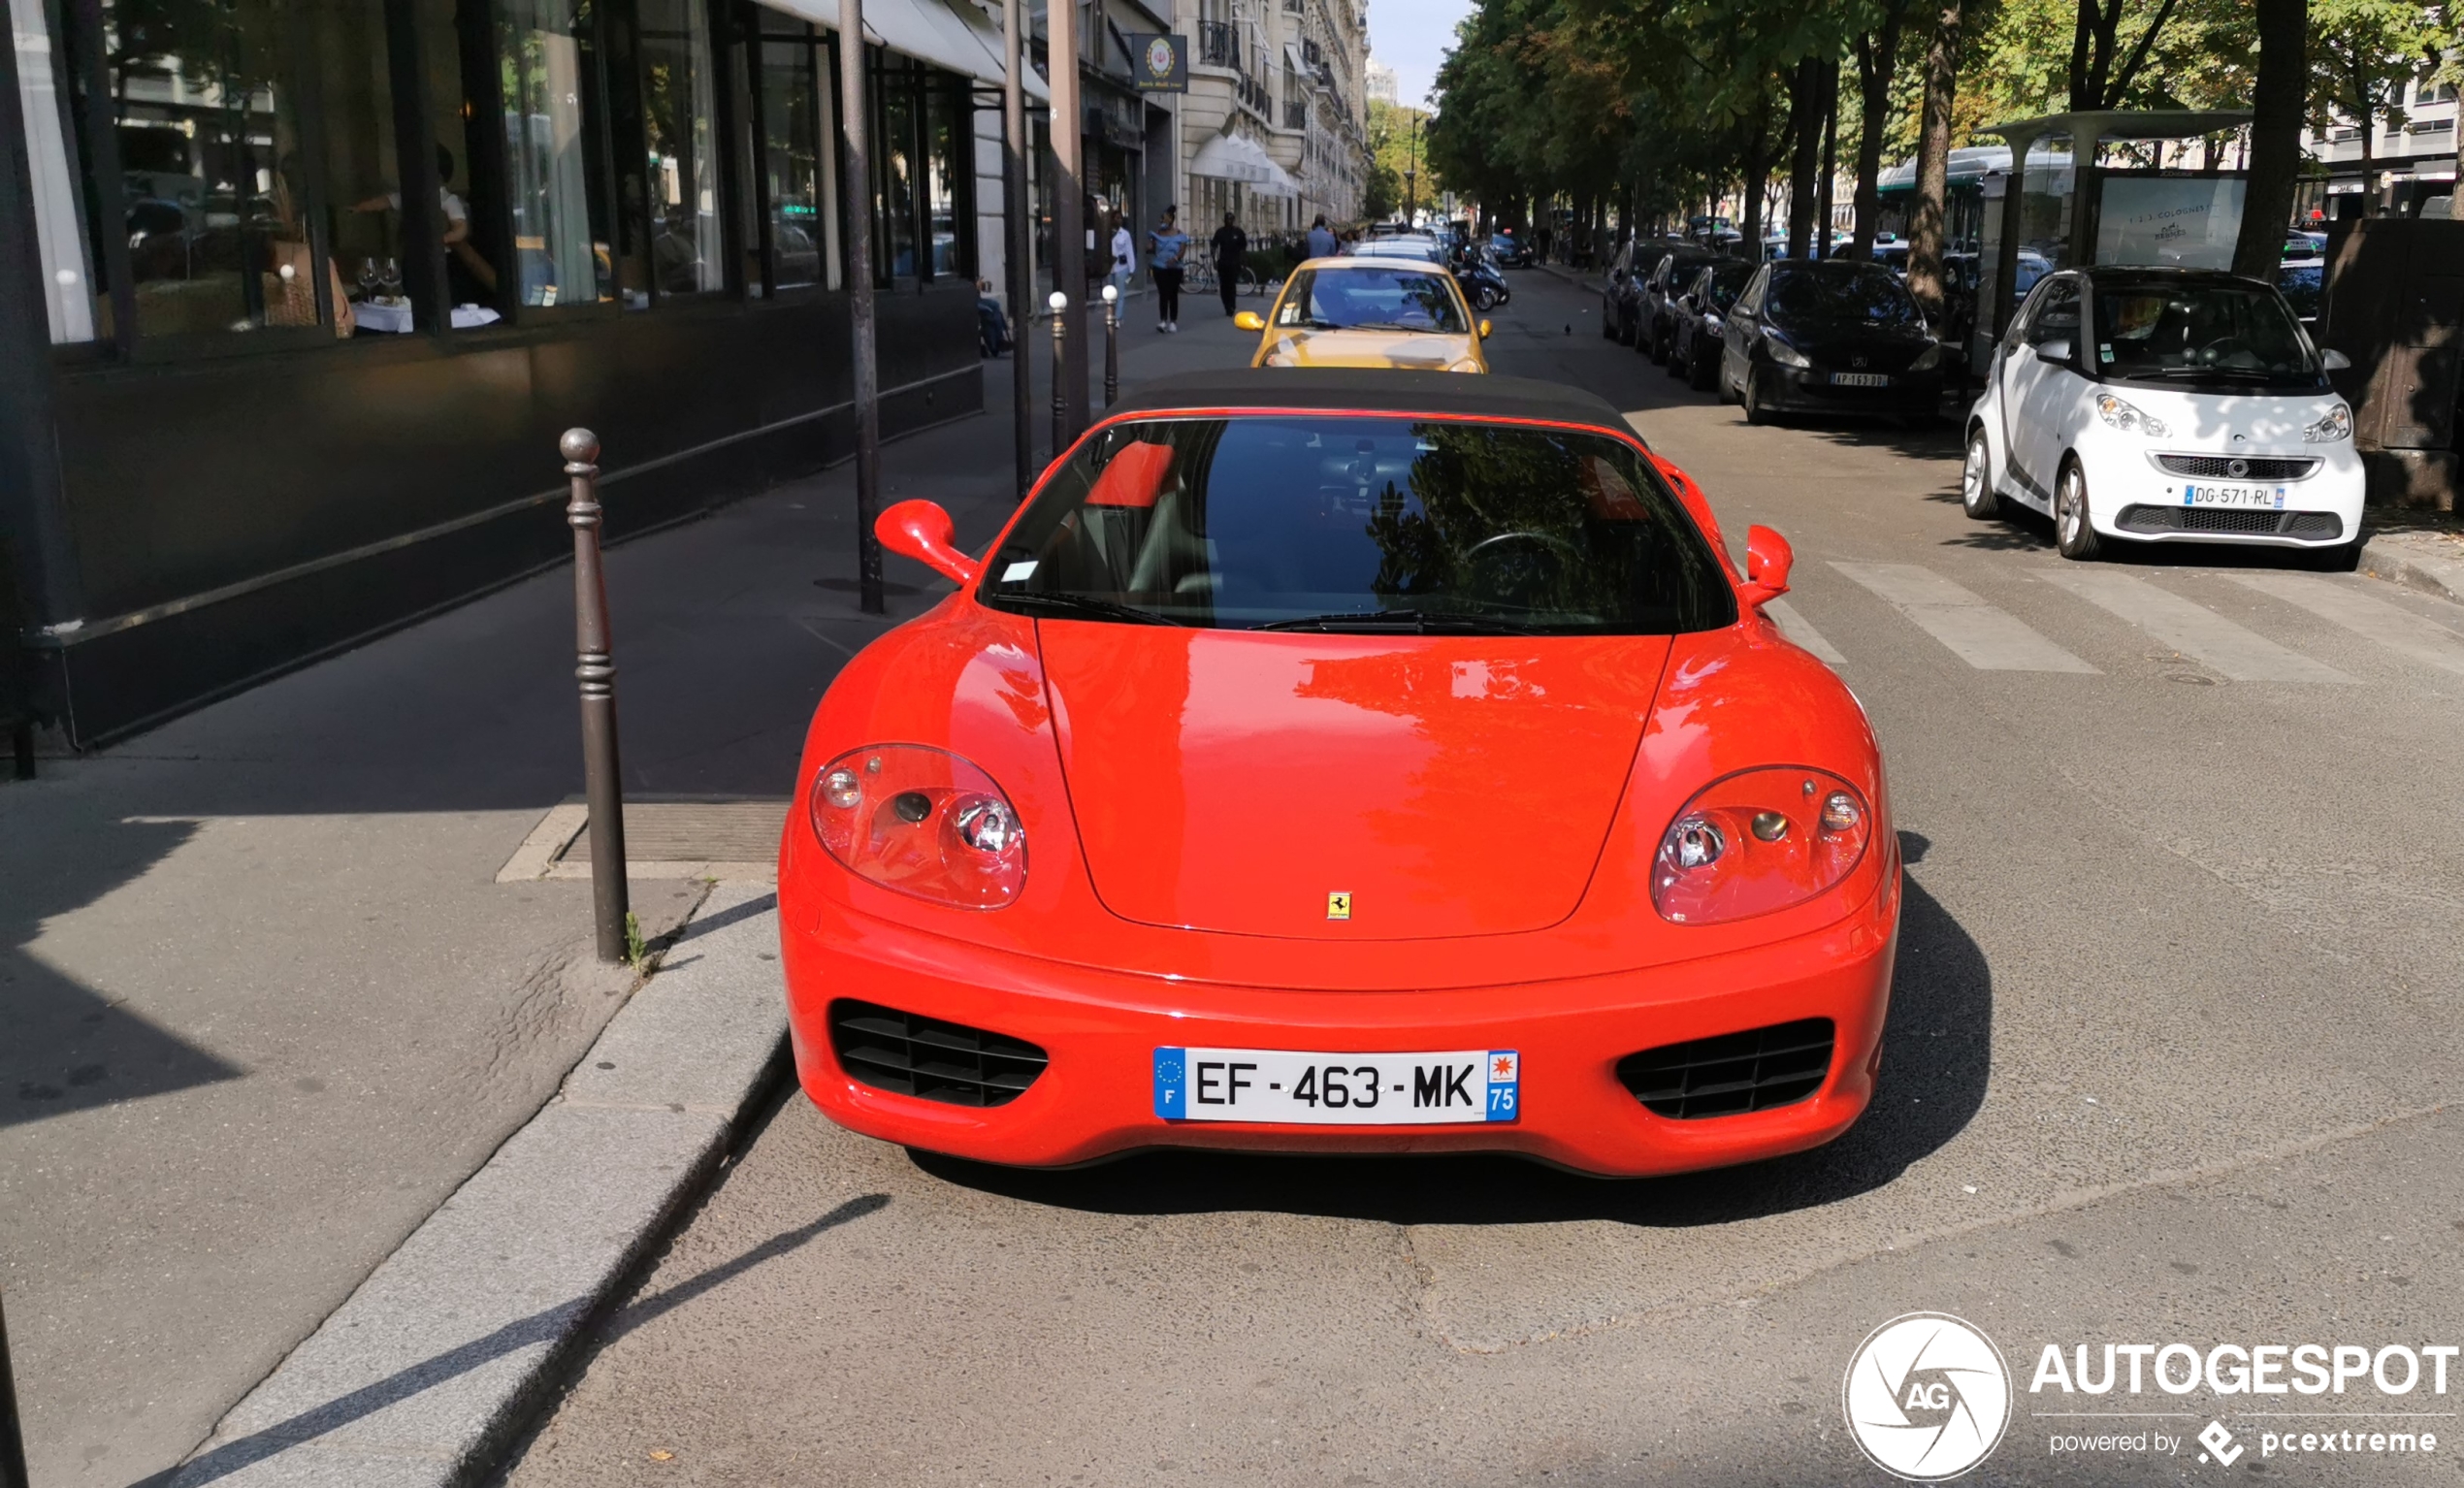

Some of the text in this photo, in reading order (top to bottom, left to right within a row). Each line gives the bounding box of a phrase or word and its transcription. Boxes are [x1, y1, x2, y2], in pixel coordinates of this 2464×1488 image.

[2195, 488, 2272, 505] DG-571-RL
[1197, 1061, 1475, 1108] EF-463-MK
[1164, 1089, 1176, 1104] F
[1490, 1087, 1514, 1111] 75
